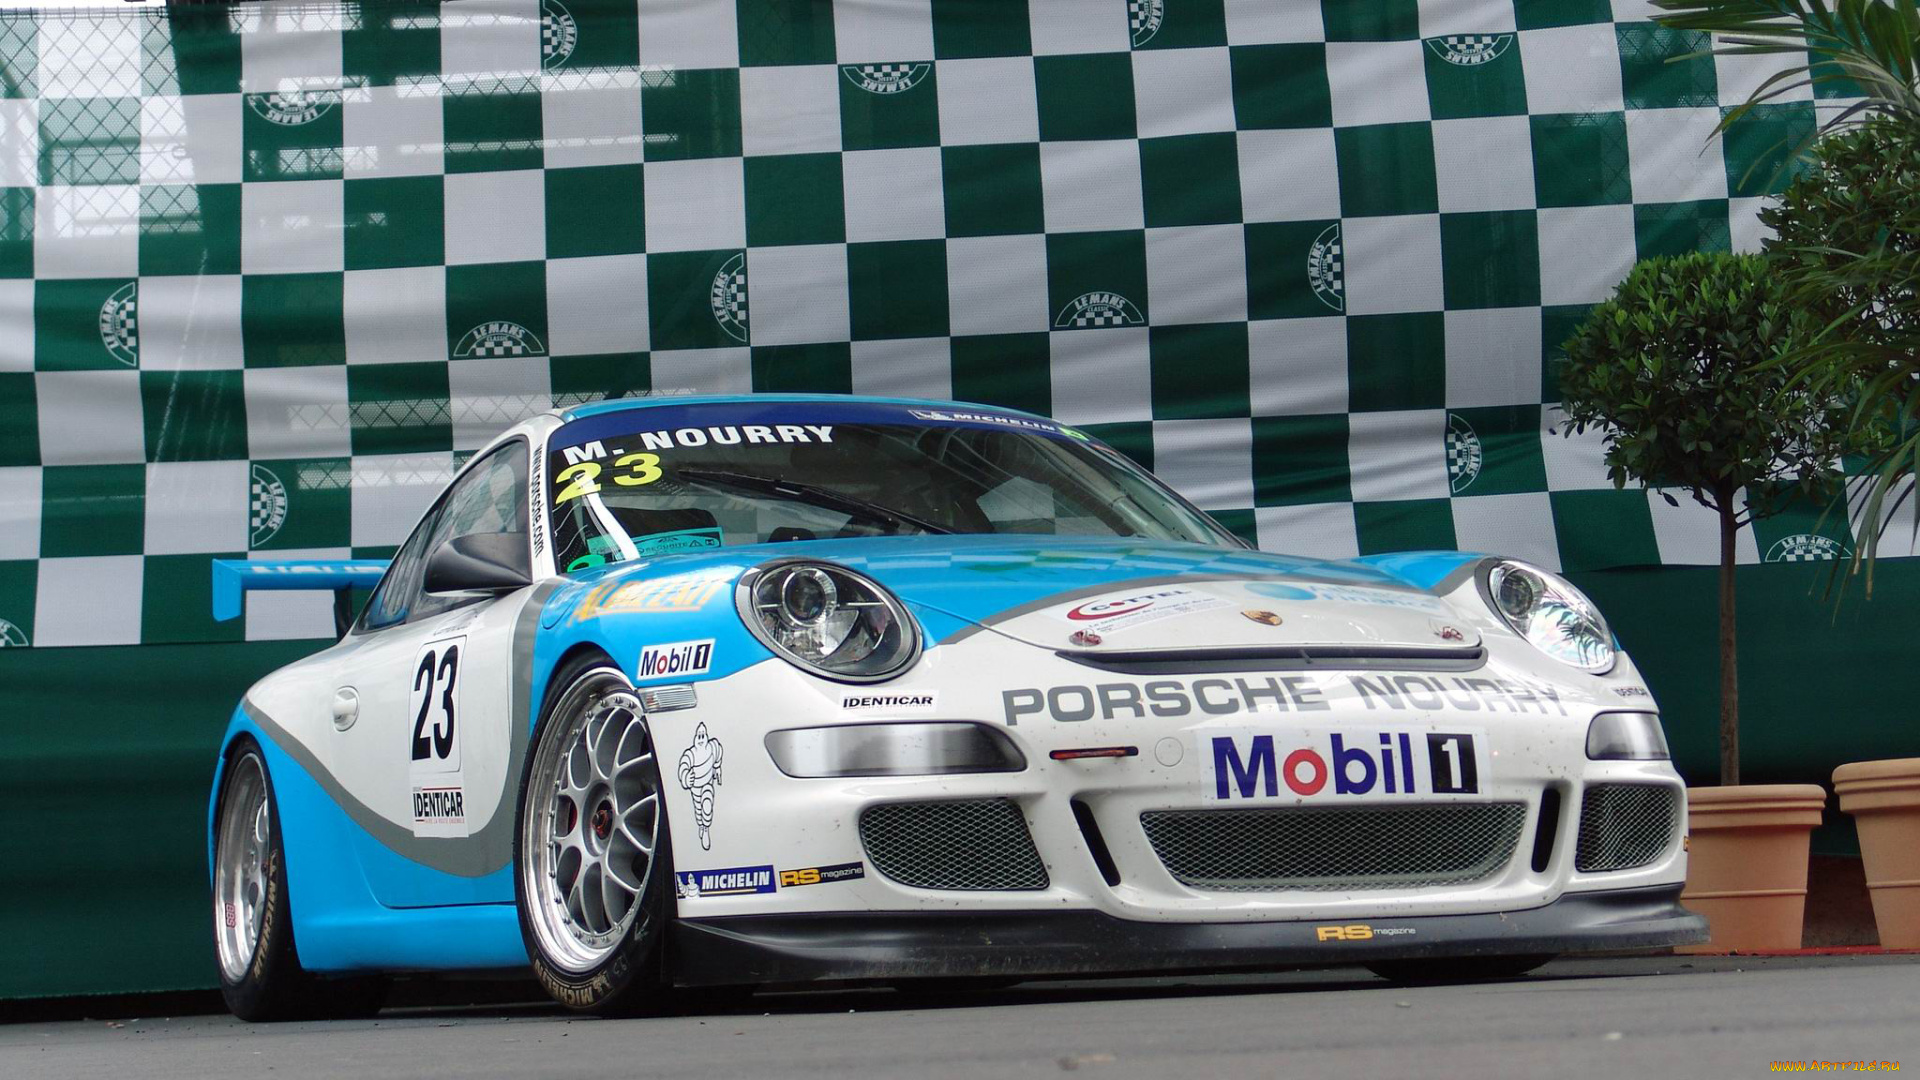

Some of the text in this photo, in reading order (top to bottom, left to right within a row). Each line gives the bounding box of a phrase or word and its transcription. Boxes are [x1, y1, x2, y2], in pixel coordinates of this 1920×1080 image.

[954, 413, 1056, 431] MICHELIN
[563, 425, 833, 465] M. NOURRY
[556, 453, 663, 504] 23
[640, 646, 693, 676] Mobil
[412, 645, 459, 760] 23
[843, 696, 934, 708] IDENTICAR
[1002, 675, 1568, 727] PORSCHE NOURRY
[1211, 732, 1416, 800] Mobil
[412, 791, 464, 817] IDENTICAR
[701, 871, 770, 890] MICHELIN
[780, 867, 863, 887] RS magazine
[1316, 925, 1417, 941] RS magazine
